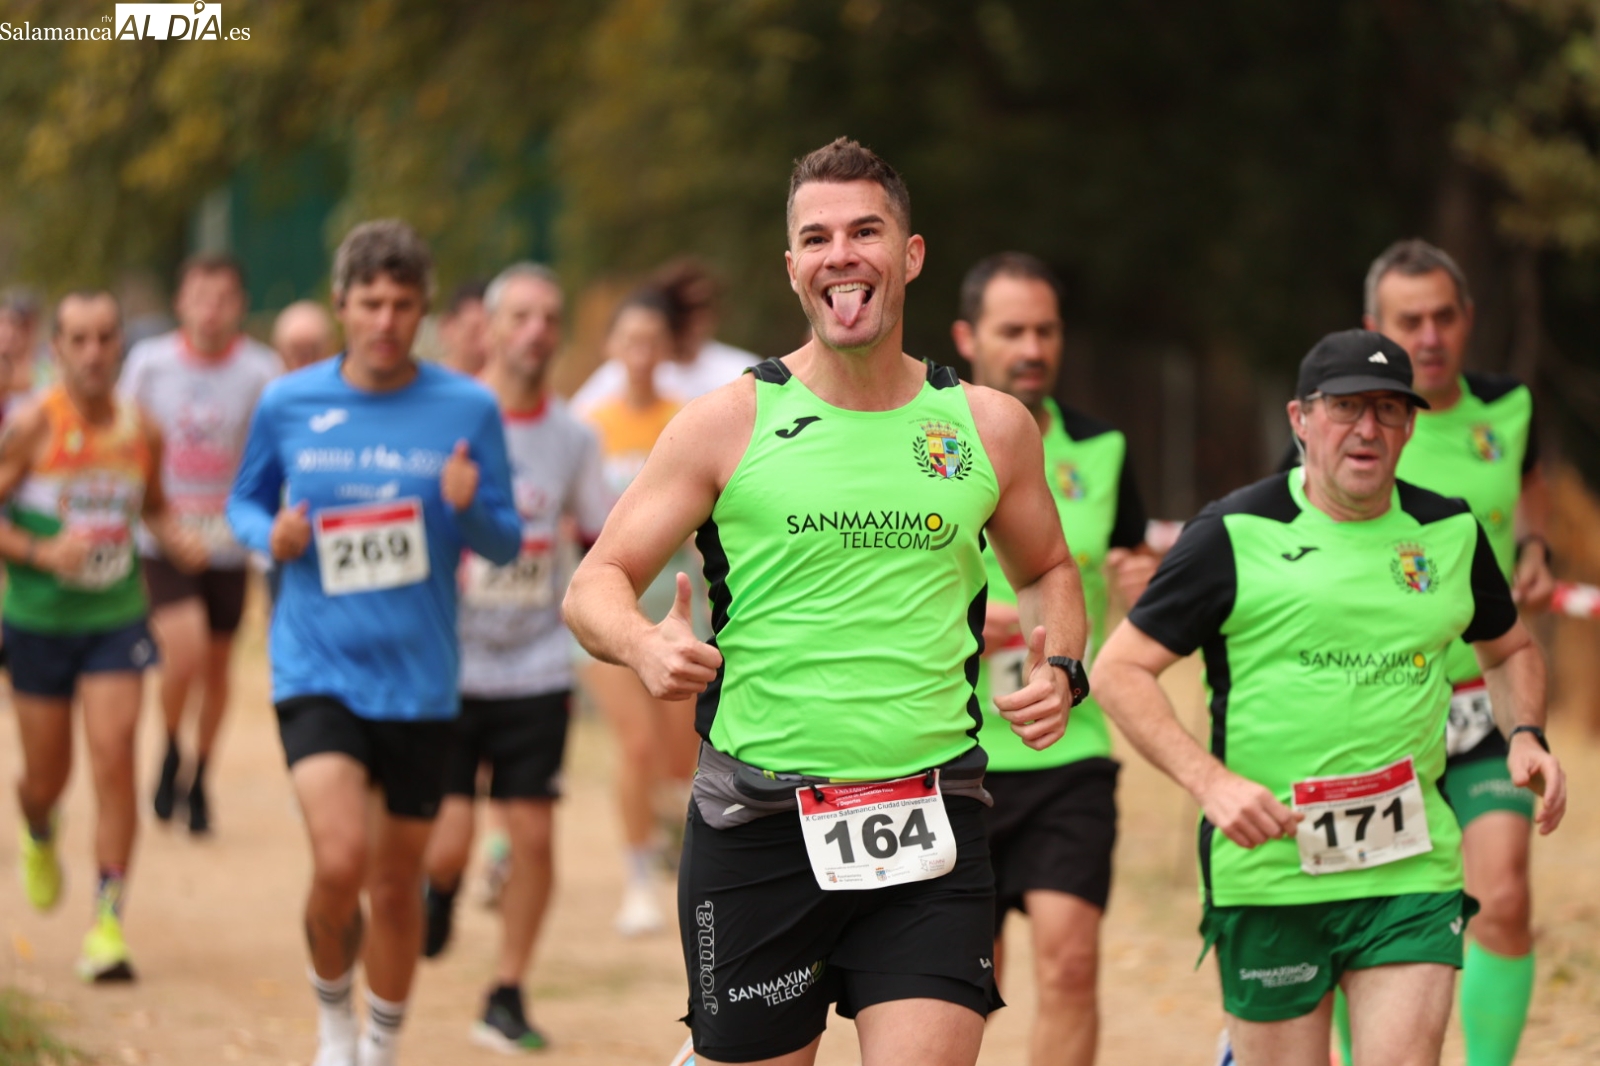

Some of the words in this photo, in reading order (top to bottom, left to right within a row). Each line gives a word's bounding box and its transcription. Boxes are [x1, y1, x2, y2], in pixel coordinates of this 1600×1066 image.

[786, 510, 943, 535] SANMAXIMO
[331, 528, 411, 571] 269
[839, 531, 931, 551] TELECOM
[1299, 650, 1427, 670] SANMAXIMO
[1344, 669, 1420, 687] TELECOM
[811, 812, 838, 822] Carrera
[838, 804, 877, 817] Salamanca
[877, 800, 900, 810] Ciudad
[1312, 796, 1405, 848] 171
[824, 807, 937, 865] 164
